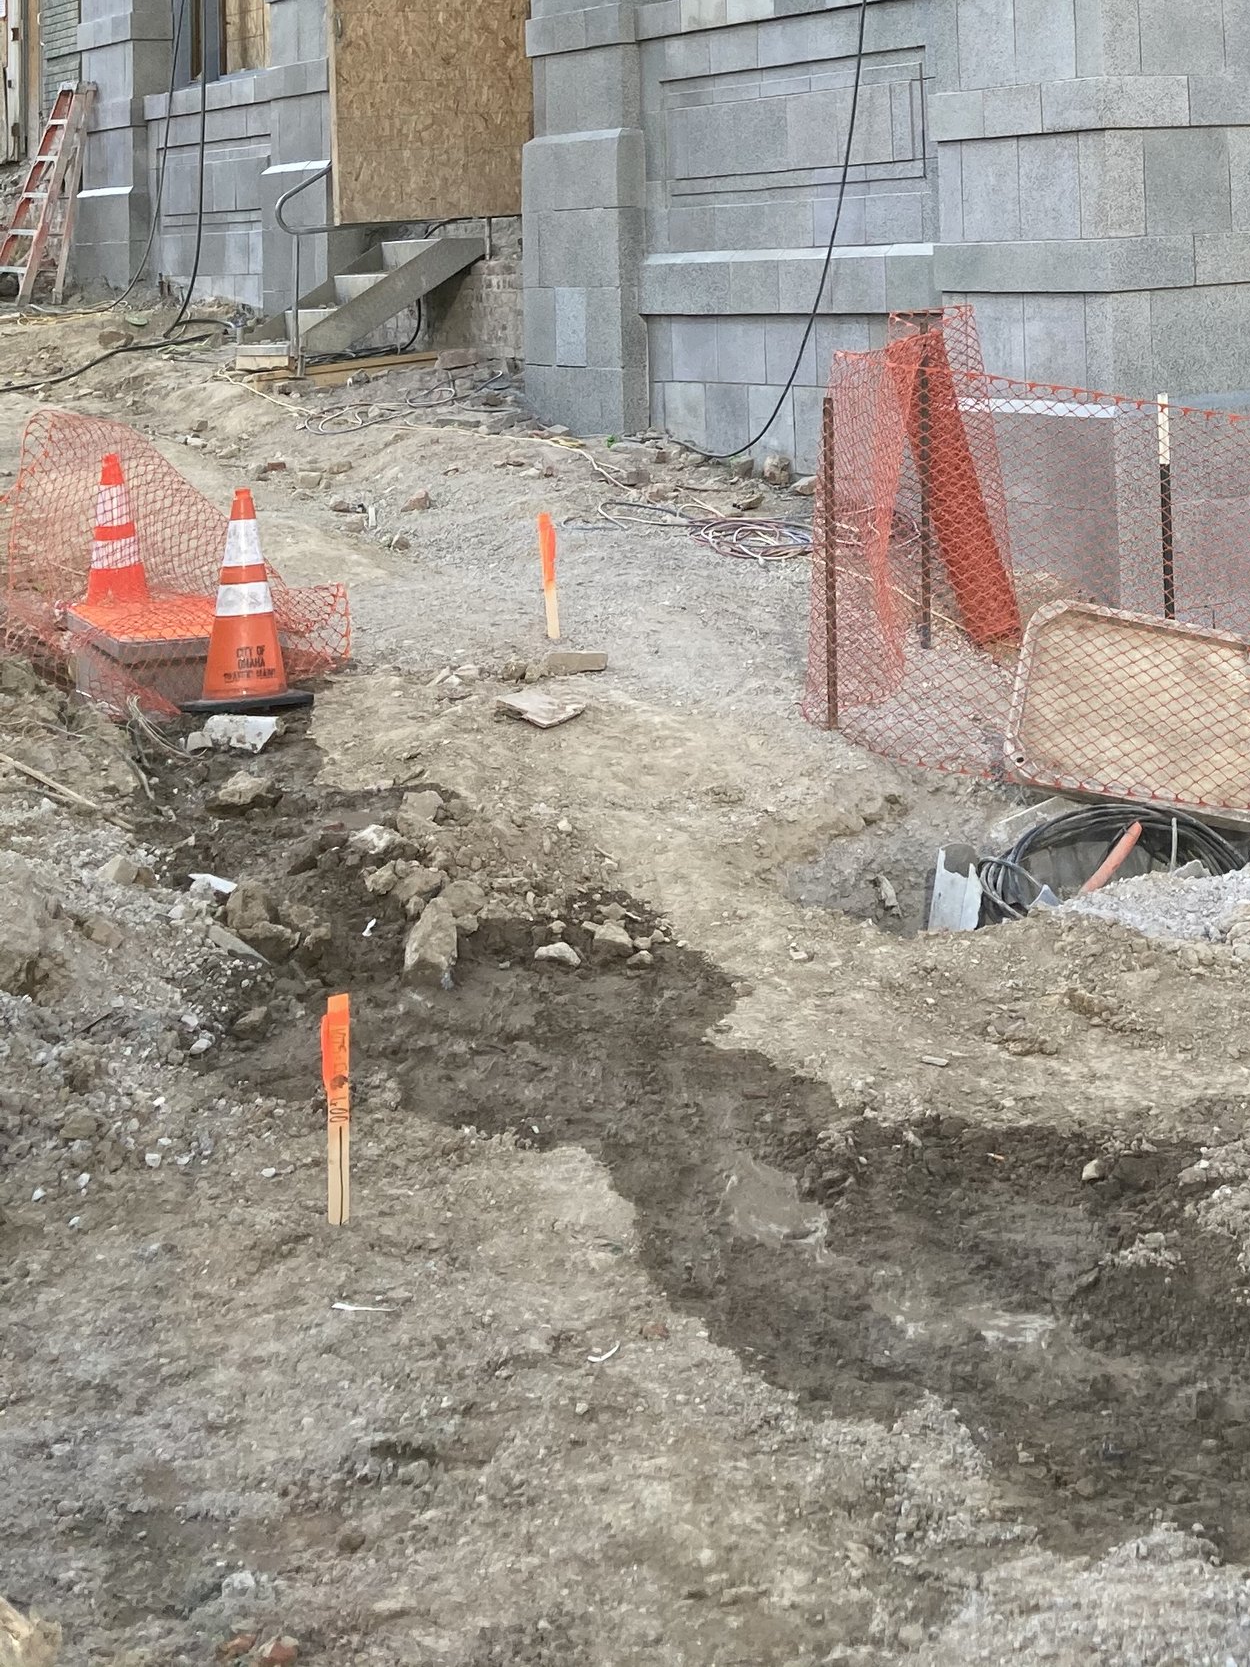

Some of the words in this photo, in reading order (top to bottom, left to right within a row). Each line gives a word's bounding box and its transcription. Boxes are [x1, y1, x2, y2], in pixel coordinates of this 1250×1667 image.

[237, 647, 252, 657] CITY
[257, 645, 265, 655] OF
[238, 658, 265, 669] OMAHA
